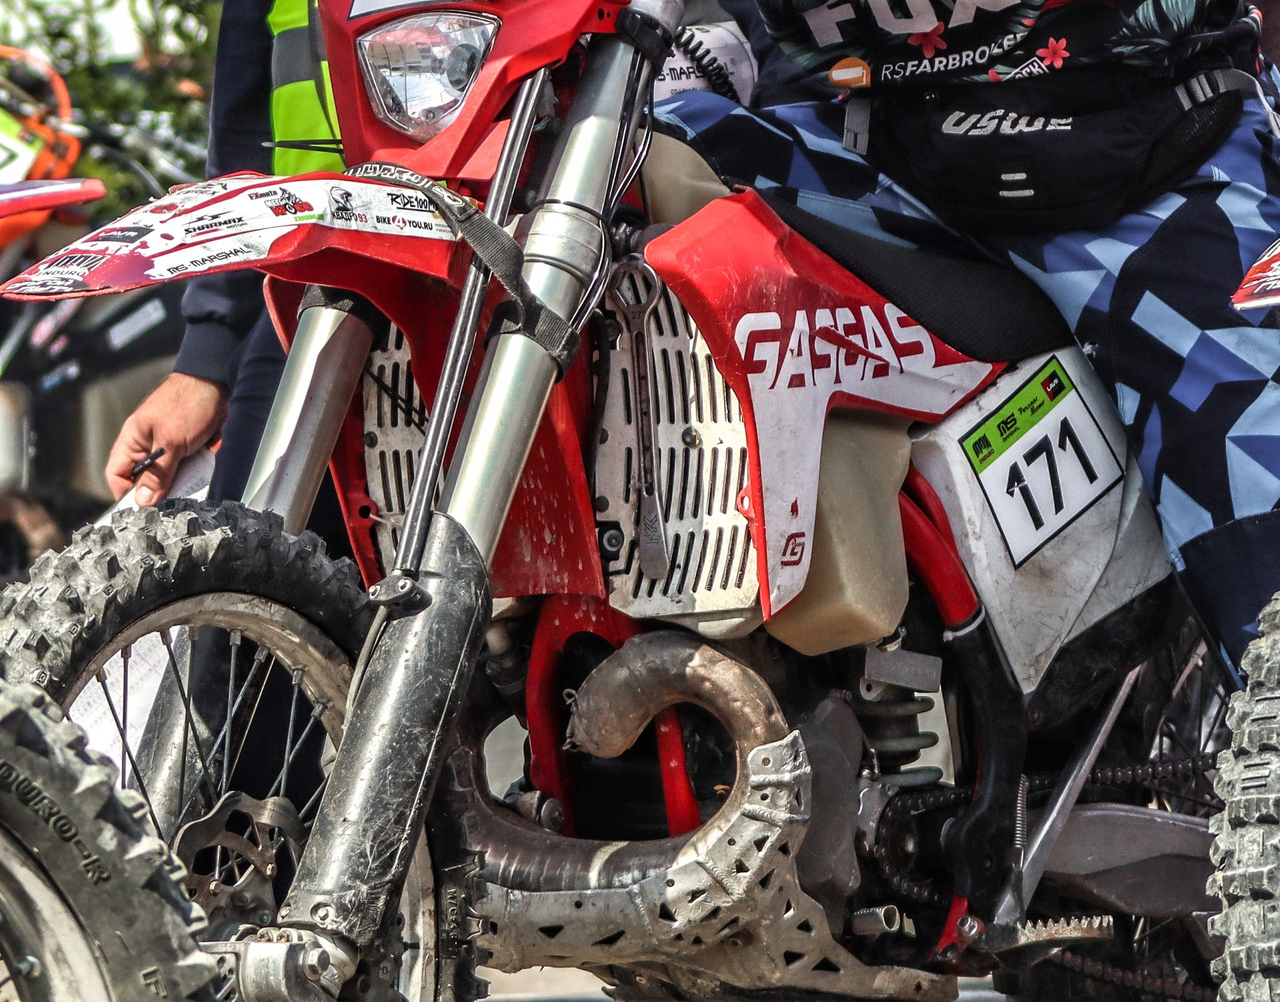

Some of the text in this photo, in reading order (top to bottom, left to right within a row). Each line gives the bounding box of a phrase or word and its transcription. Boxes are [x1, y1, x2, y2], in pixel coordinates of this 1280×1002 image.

[184, 216, 245, 235] SHARMAX
[357, 213, 369, 223] 93
[167, 247, 251, 275] MS-MARSHAL
[733, 301, 936, 390] GASGAS
[1006, 416, 1099, 532] 171
